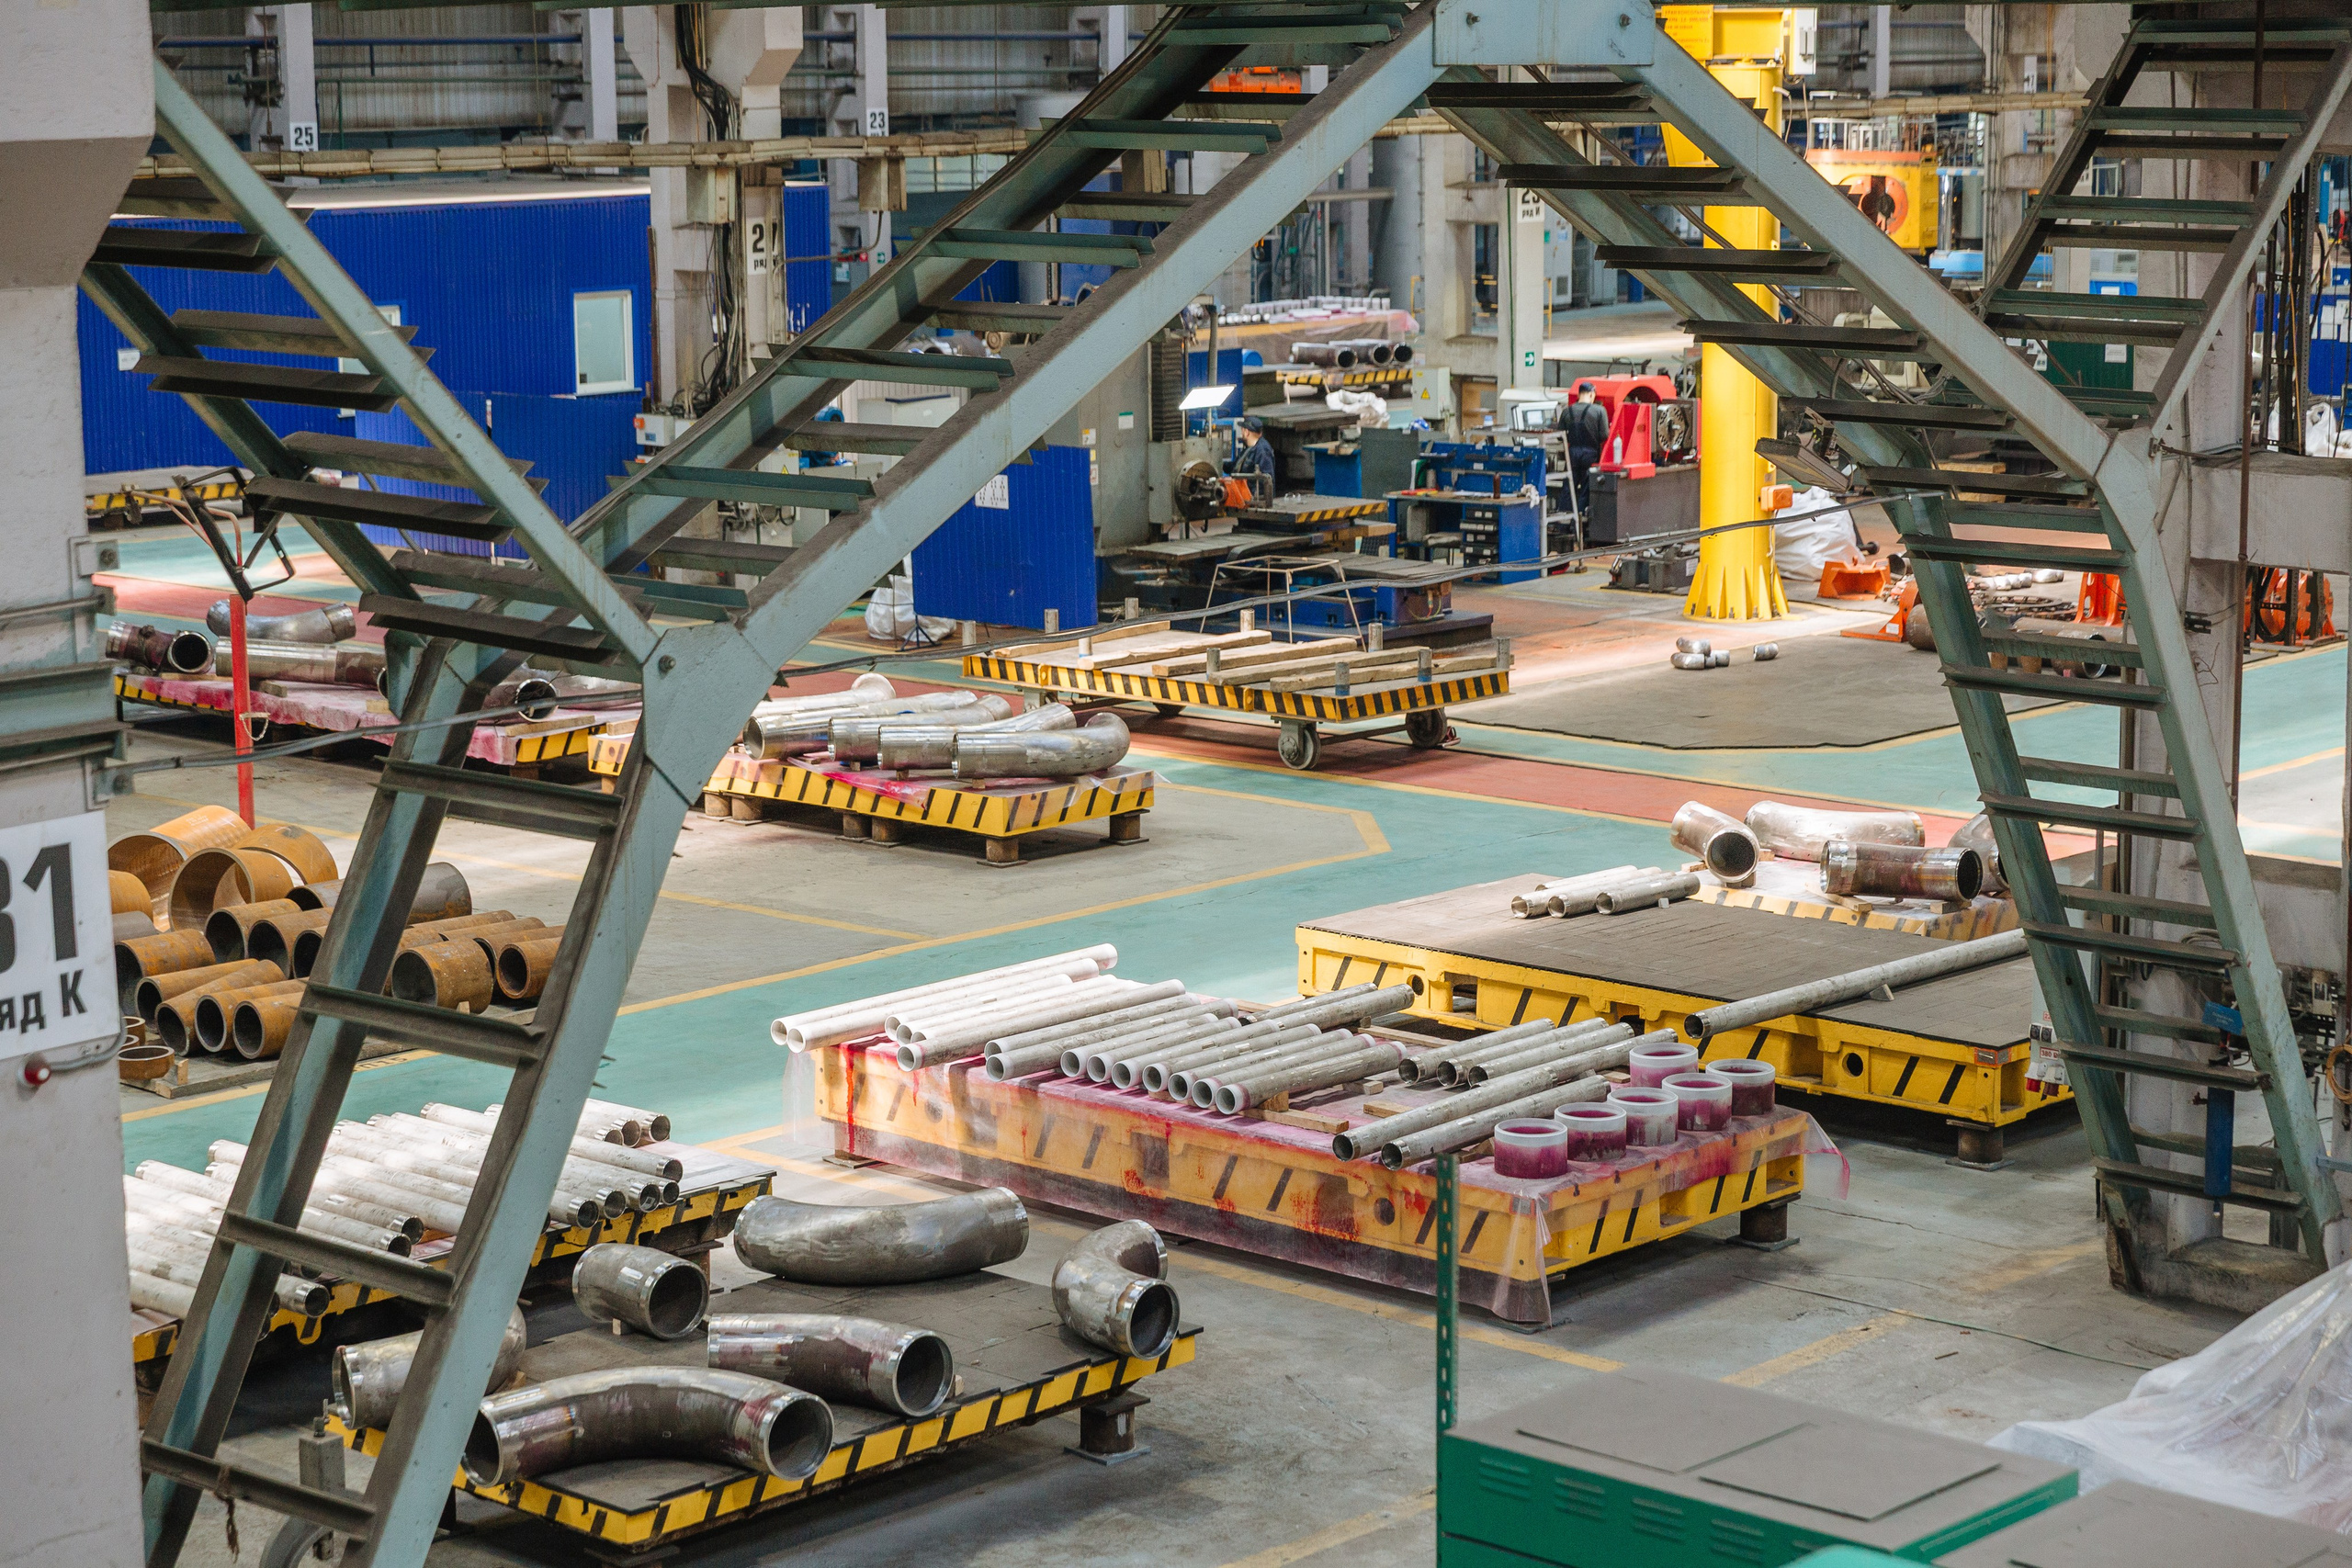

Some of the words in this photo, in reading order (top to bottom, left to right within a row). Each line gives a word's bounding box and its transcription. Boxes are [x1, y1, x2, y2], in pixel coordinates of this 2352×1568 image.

[870, 112, 886, 129] 23
[294, 127, 314, 145] 25
[60, 969, 88, 1017] К
[2041, 1049, 2052, 1058] 380
